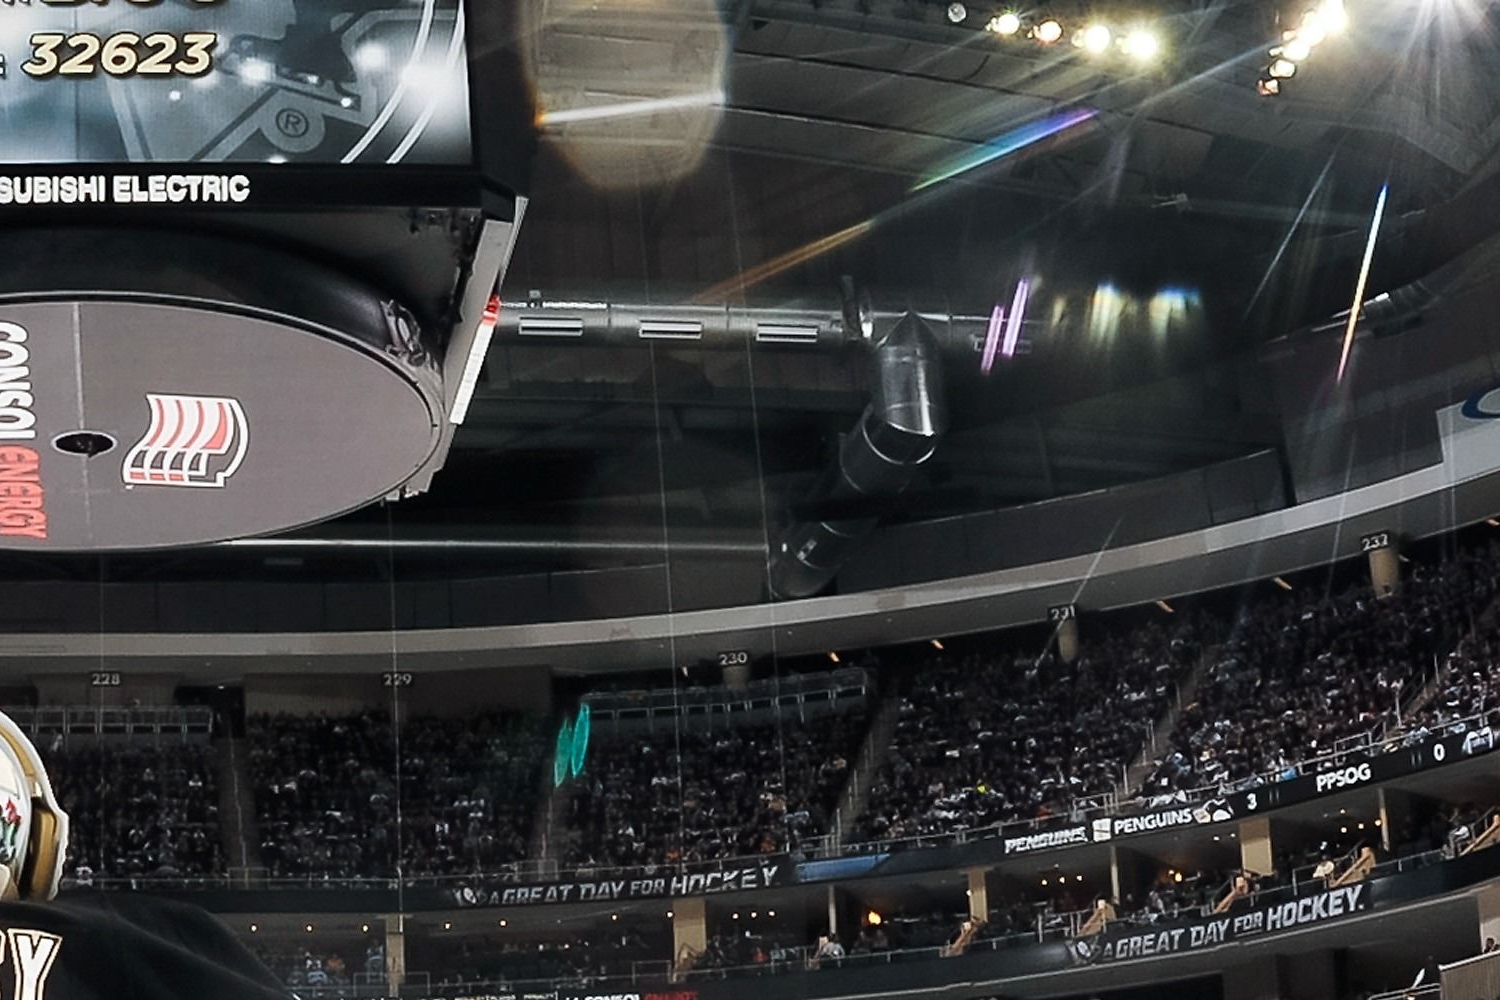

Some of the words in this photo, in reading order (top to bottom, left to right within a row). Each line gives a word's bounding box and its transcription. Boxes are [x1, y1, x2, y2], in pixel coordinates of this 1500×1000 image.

[21, 32, 217, 76] 32623
[113, 174, 250, 203] ELECTRIC
[719, 652, 747, 665] 230
[92, 673, 120, 685] 228
[383, 673, 412, 686] 229
[1433, 743, 1445, 762] 0
[1316, 764, 1371, 792] PPSOG
[1114, 809, 1192, 834] PENGUINS
[1247, 793, 1257, 810] 3
[502, 884, 573, 905] GREAT
[578, 881, 626, 900] DAY
[630, 878, 665, 895] FOR
[1115, 928, 1184, 960] GREAT
[1190, 919, 1229, 948] DAY
[1234, 912, 1263, 934] FOR
